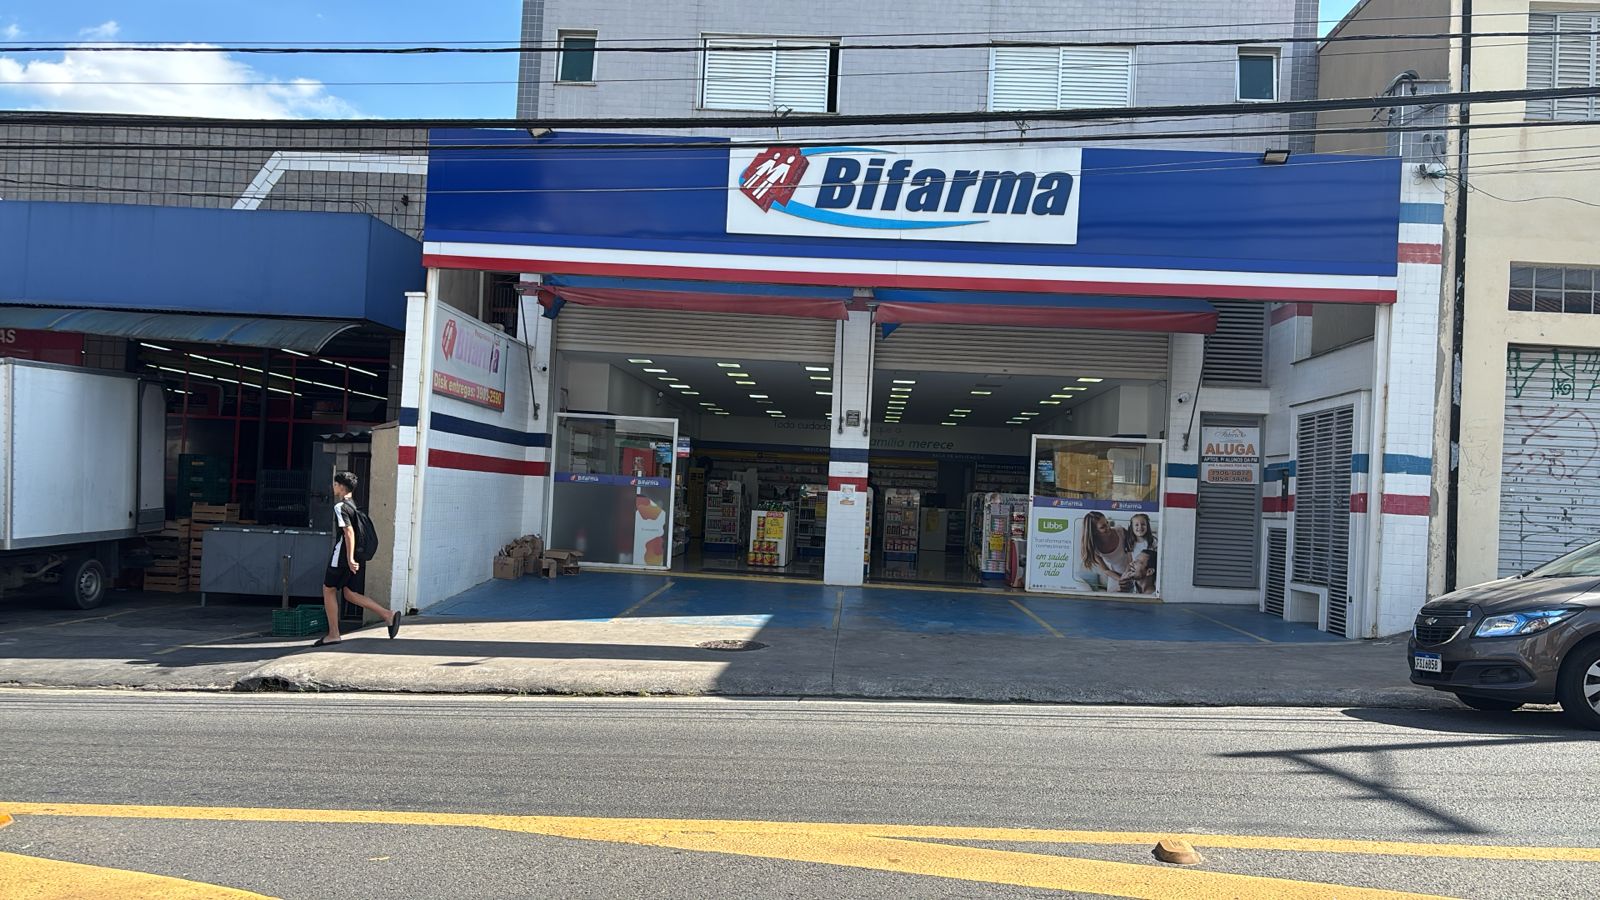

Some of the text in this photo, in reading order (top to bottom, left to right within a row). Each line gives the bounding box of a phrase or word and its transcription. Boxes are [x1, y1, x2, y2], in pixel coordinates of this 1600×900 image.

[815, 157, 1074, 216] Bifarma
[434, 372, 449, 389] Disk
[449, 381, 476, 398] entregas:
[909, 439, 954, 450] merece
[1205, 443, 1256, 455] ALUGA
[1119, 502, 1142, 510] Bifarma
[1043, 521, 1063, 530] Libbs
[1048, 552, 1069, 561] saúde
[1038, 561, 1051, 569] pra
[1044, 568, 1061, 577] vida
